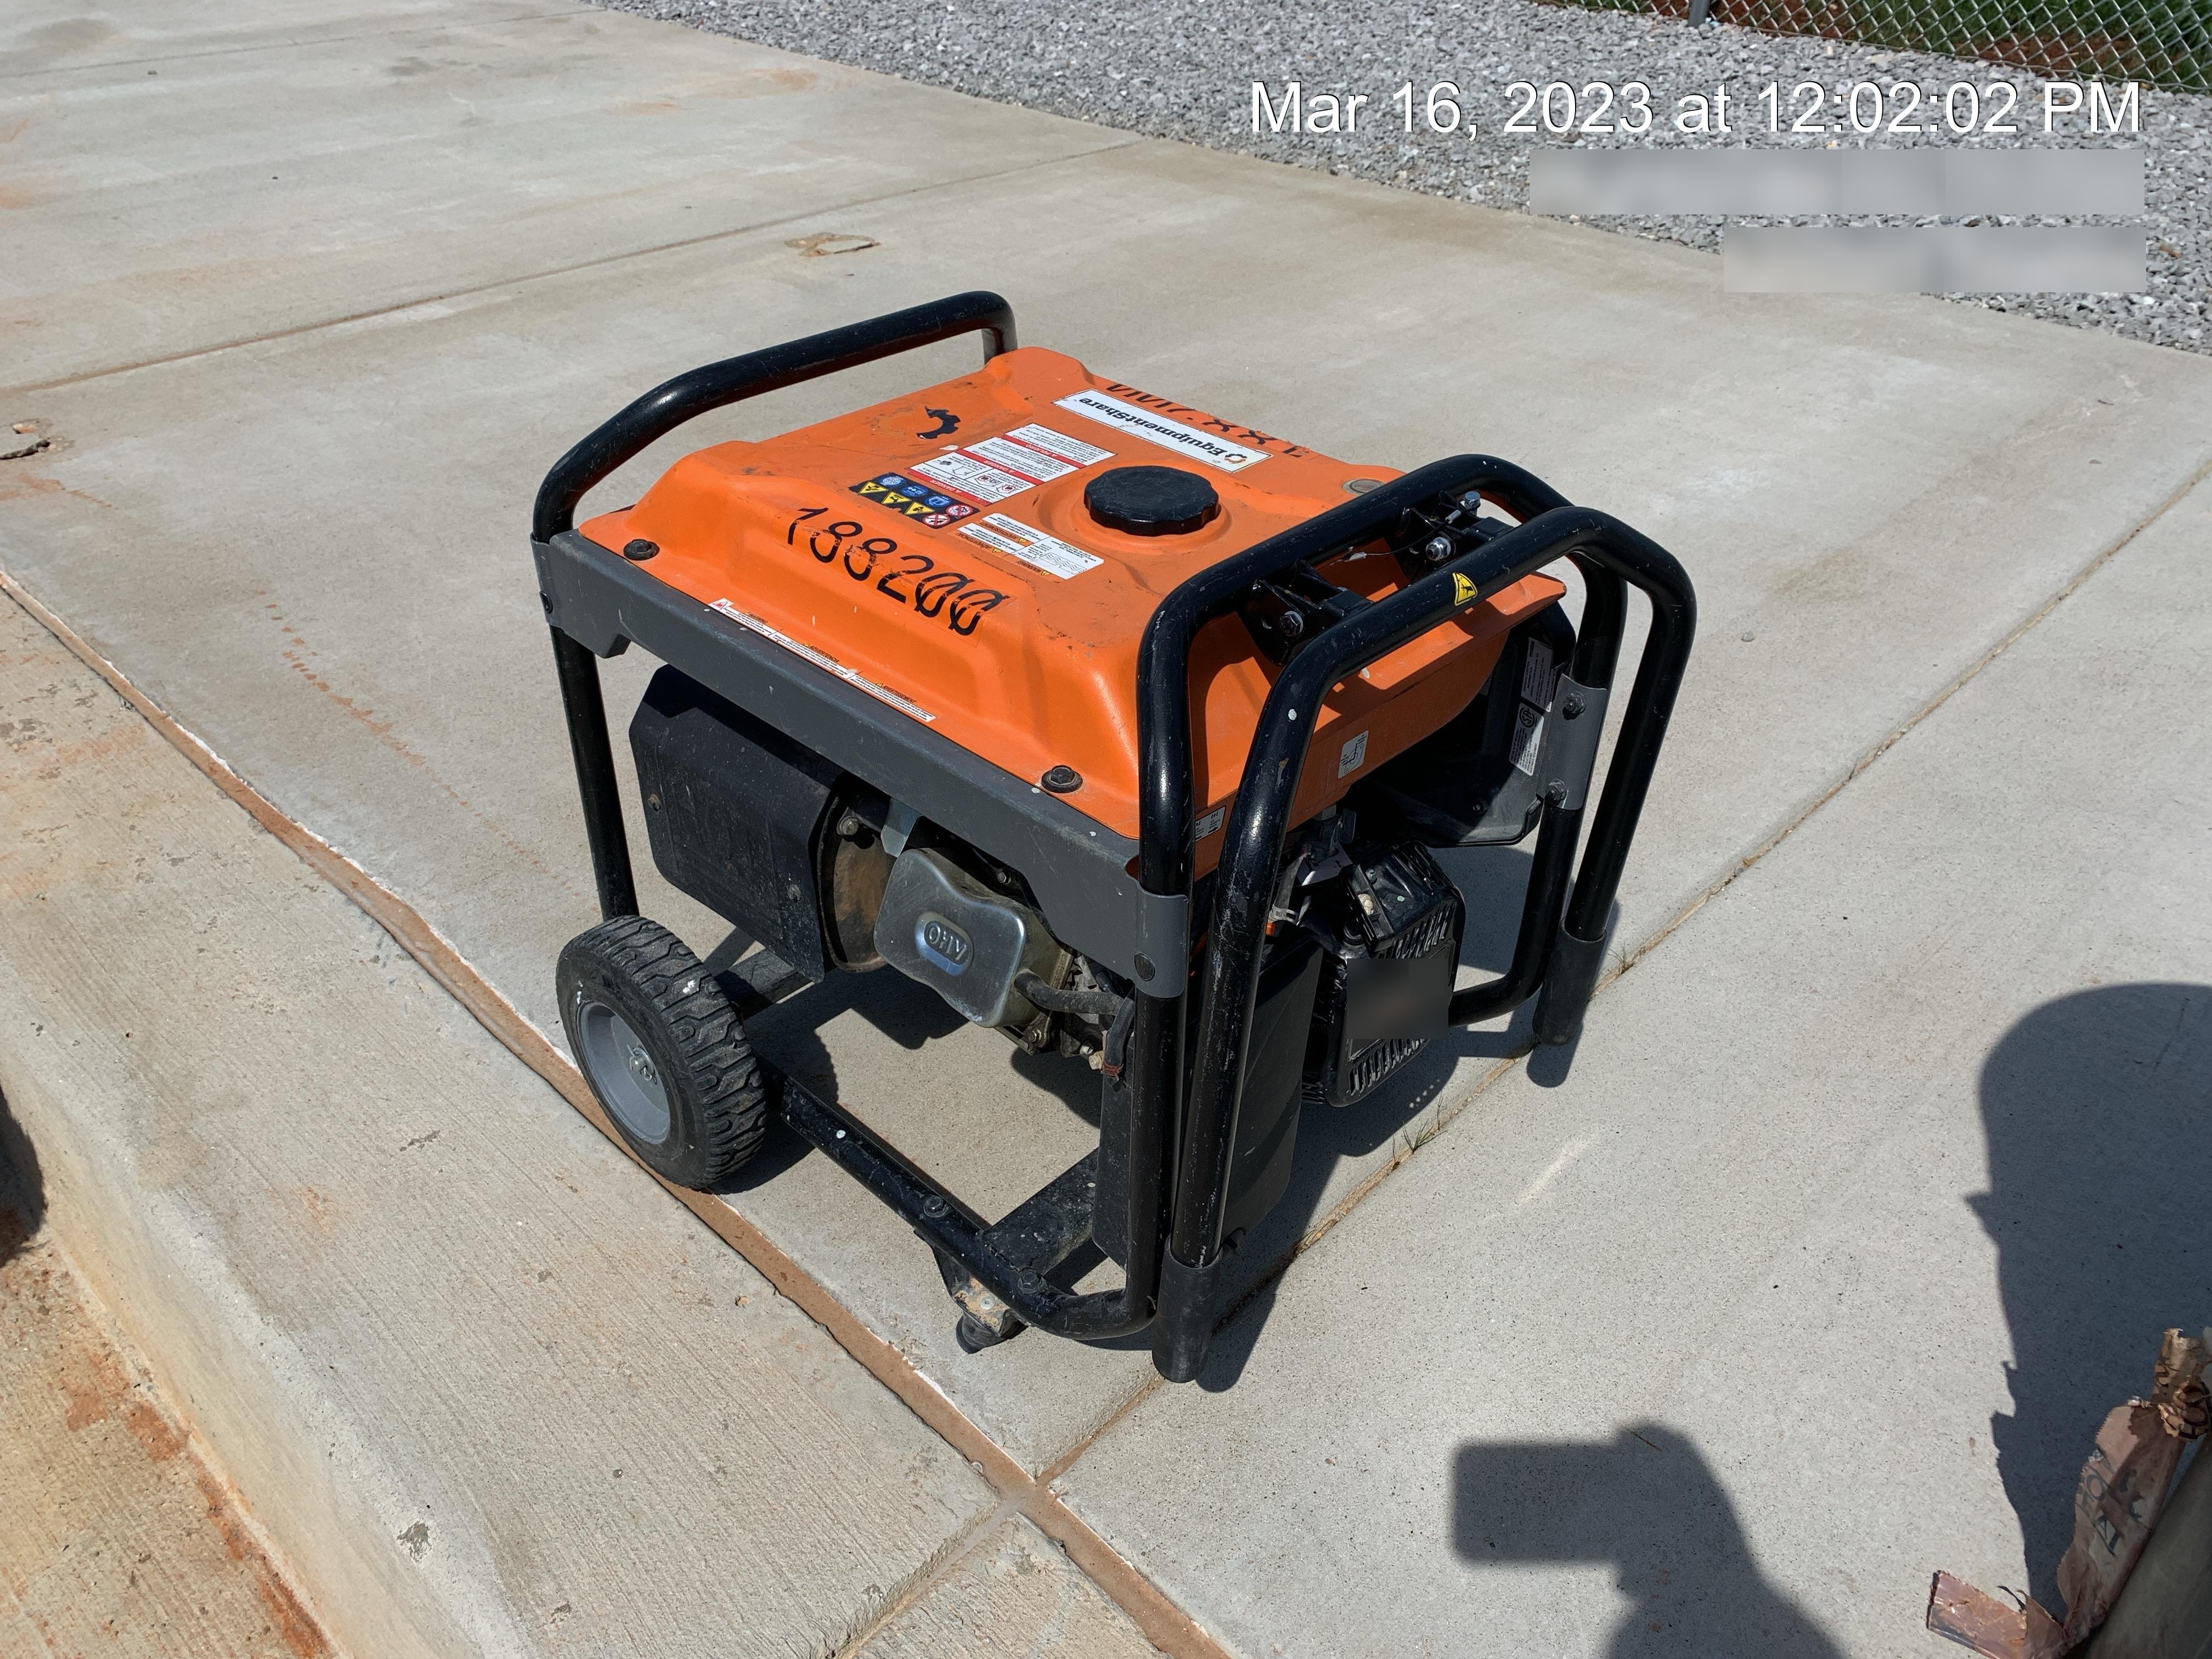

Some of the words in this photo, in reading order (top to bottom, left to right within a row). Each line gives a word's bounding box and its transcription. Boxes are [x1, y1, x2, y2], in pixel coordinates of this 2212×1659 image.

[1079, 397, 1227, 457] EquipmentShare
[982, 460, 1009, 471] DANGER
[929, 479, 957, 491] DANGER
[787, 506, 1010, 636] 188200
[928, 924, 967, 961] OHV
